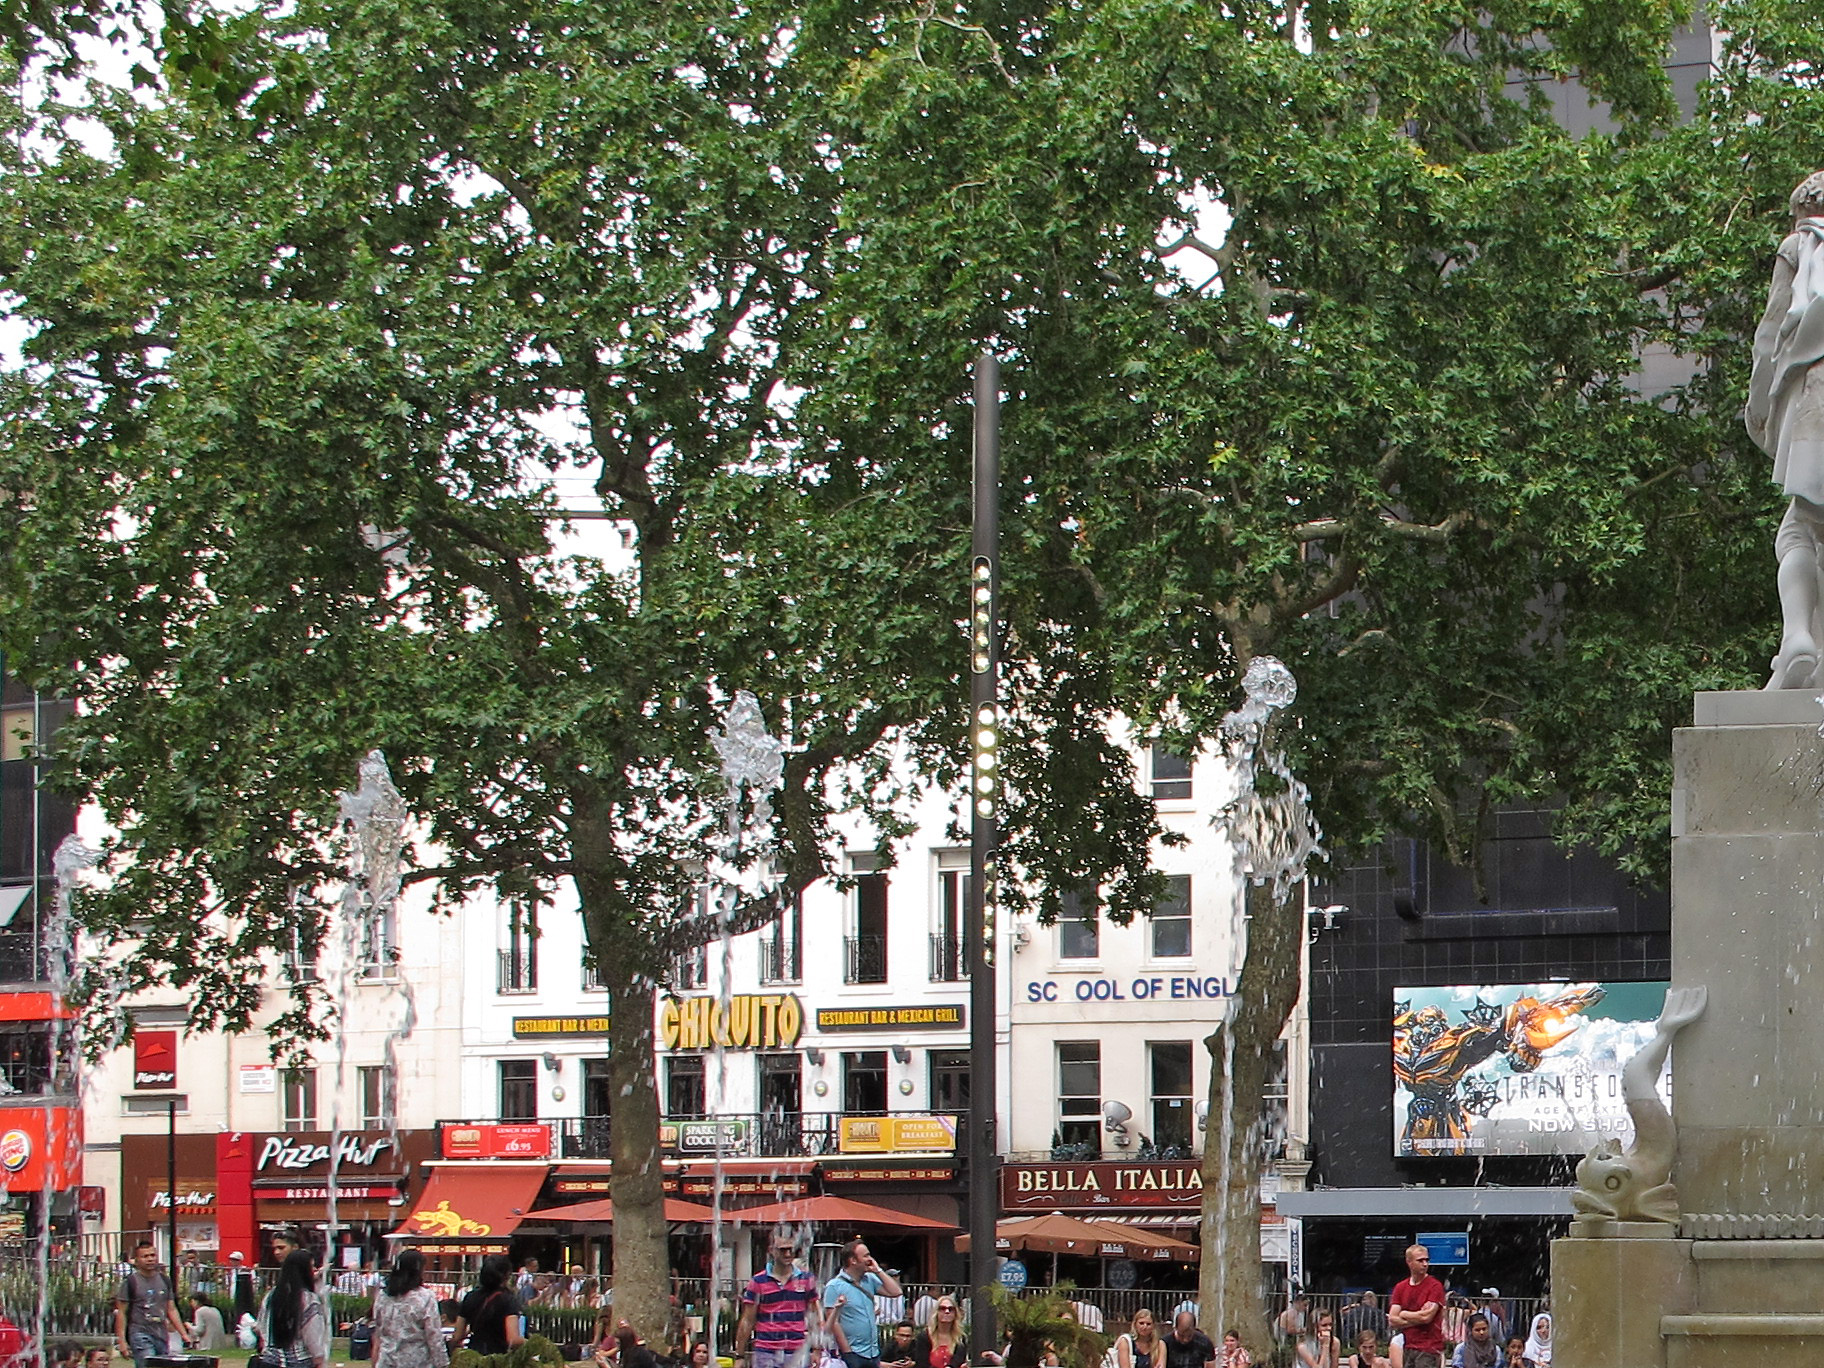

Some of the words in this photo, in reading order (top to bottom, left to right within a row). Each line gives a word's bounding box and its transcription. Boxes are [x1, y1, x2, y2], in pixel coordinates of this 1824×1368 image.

[1132, 978, 1164, 1000] OF
[1170, 977, 1234, 998] ENGL
[661, 995, 800, 1049] CHIQUITO
[819, 1011, 869, 1026] RESTAURANT
[871, 1010, 887, 1024] BAR
[889, 1010, 896, 1023] &
[898, 1009, 934, 1023] MEXICAN
[935, 1008, 959, 1022] GRILL
[1529, 1119, 1574, 1132] NOW
[258, 1137, 330, 1170] Pizza
[337, 1135, 392, 1166] Hut
[1017, 1169, 1101, 1192] BELLA
[1115, 1168, 1203, 1191] ITALIA
[286, 1187, 370, 1198] RESTARANT
[1001, 1271, 1025, 1283] £7.95
